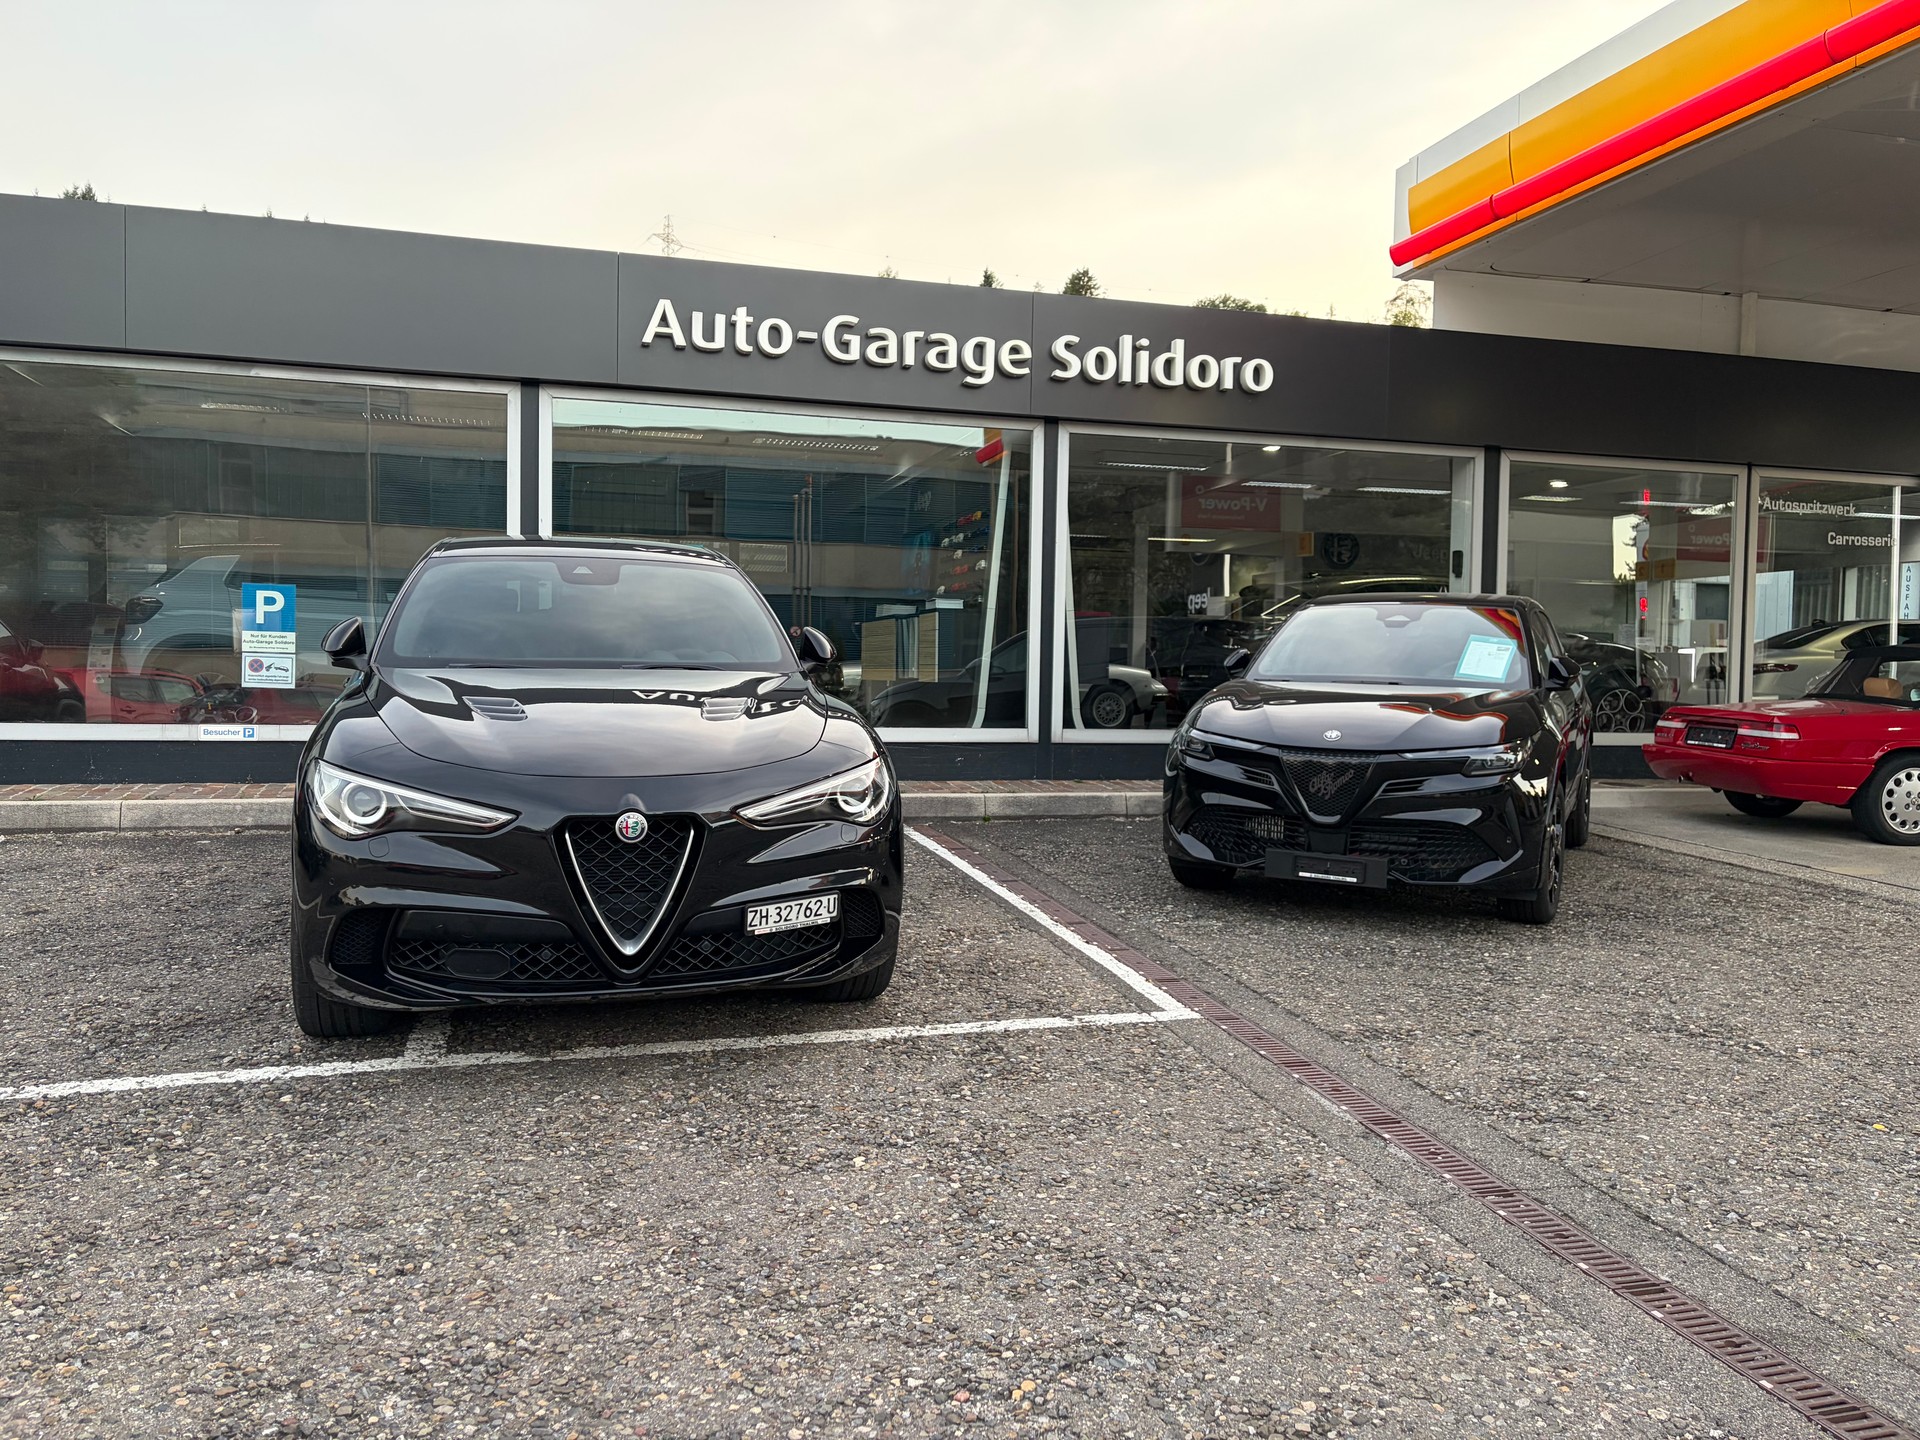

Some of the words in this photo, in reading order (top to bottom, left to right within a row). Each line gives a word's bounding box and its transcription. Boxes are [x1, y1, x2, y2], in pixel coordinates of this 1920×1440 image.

[641, 298, 1033, 388] Auto-Garage
[1049, 334, 1275, 395] Solidoro
[1763, 497, 1856, 516] Autospritzwerk
[1827, 532, 1897, 547] Carrosserie
[255, 590, 285, 624] P
[203, 728, 241, 737] Besucher
